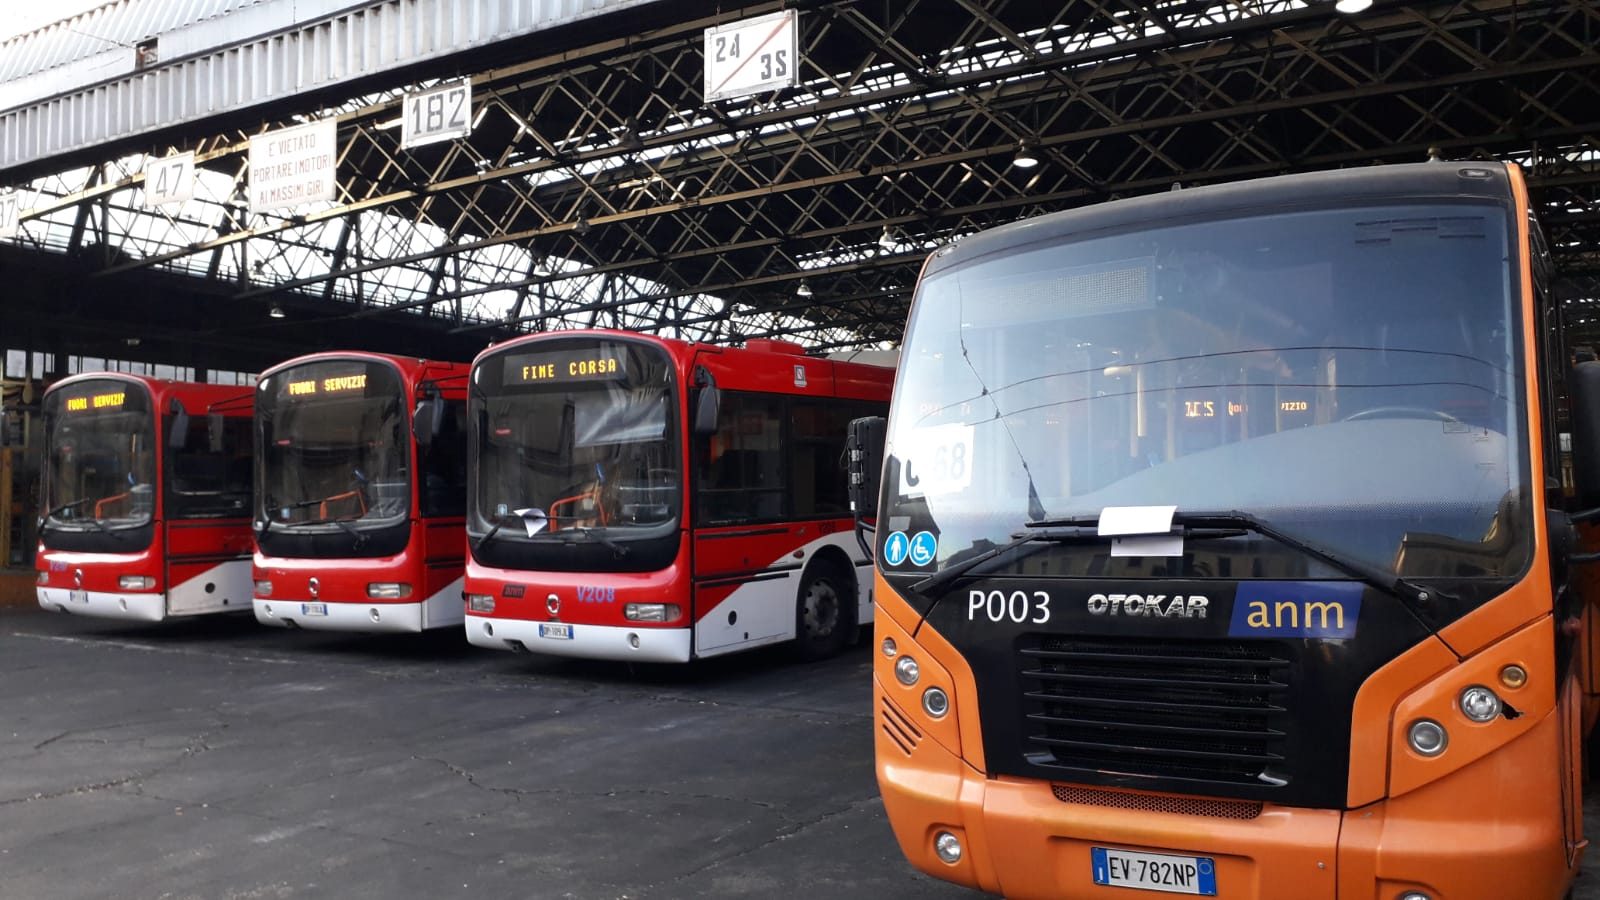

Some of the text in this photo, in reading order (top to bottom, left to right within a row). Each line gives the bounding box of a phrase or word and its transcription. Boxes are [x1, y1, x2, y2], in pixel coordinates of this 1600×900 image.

[716, 33, 740, 63] 24
[761, 50, 786, 80] 3S
[412, 88, 465, 135] 182
[278, 133, 317, 155] VIETATO
[156, 163, 184, 198] 47
[253, 161, 294, 184] PORTARE
[299, 153, 331, 175] MOTORI
[270, 183, 304, 203] MASSIMI
[306, 179, 324, 197] GIRI
[522, 358, 617, 380] FINE CORSA
[576, 585, 616, 603] V208
[1087, 594, 1210, 619] OTOKAR
[1247, 600, 1345, 630] anm
